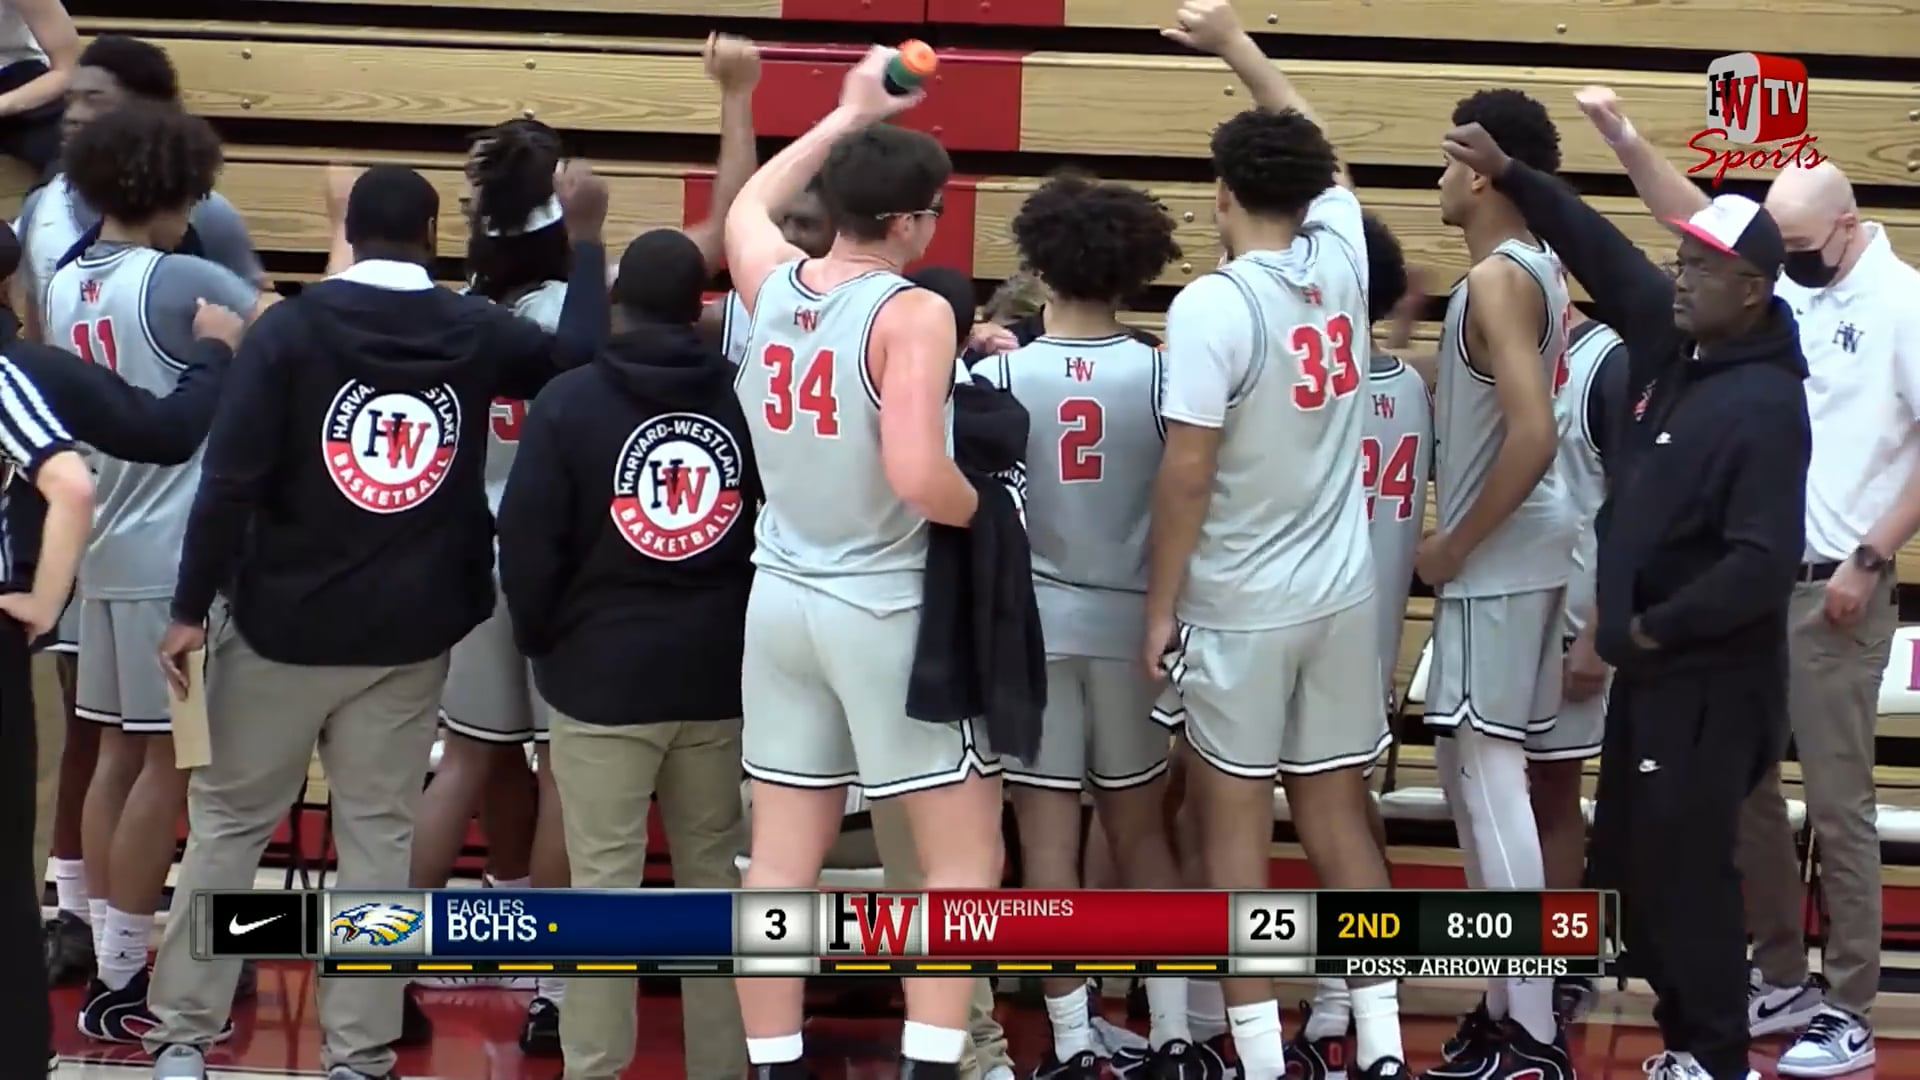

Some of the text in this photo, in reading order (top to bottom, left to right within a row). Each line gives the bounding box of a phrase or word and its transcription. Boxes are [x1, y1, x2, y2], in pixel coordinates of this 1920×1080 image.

[761, 343, 840, 438] 34
[1064, 357, 1096, 382] HW
[1288, 312, 1360, 412] 33
[363, 409, 431, 469] HW
[619, 420, 739, 494] HARVARD-WESTLAKE
[1057, 396, 1105, 484] 2
[332, 451, 449, 507] BASKETBALL
[649, 459, 711, 516] HW
[620, 502, 737, 553] BASKETBALL
